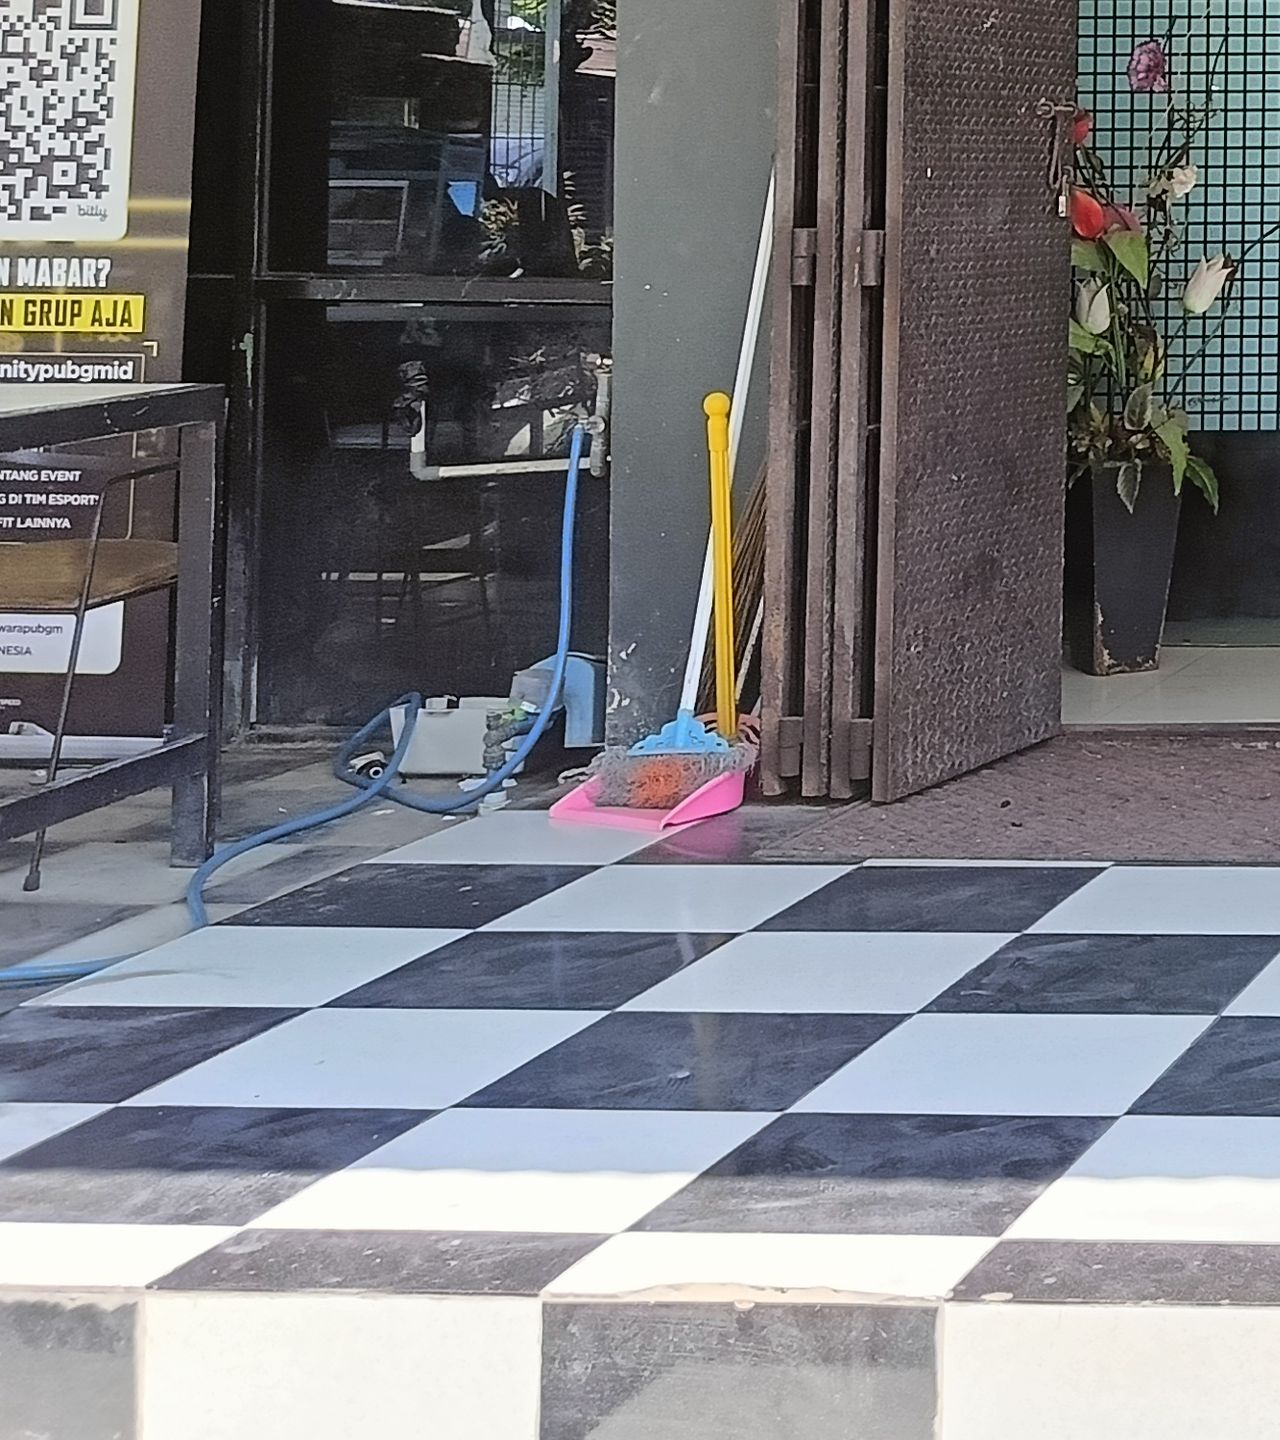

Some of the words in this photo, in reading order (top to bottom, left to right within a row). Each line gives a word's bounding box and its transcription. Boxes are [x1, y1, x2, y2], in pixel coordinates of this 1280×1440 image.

[77, 204, 108, 222] bitly
[16, 257, 111, 288] MABAR?
[23, 299, 82, 327] GRUP
[90, 300, 133, 328] AJA
[0, 360, 134, 382] nitypubgmid
[40, 470, 82, 482] EVENT
[8, 494, 23, 505] DI
[24, 494, 47, 505] TIM
[16, 517, 72, 529] LAINNYA
